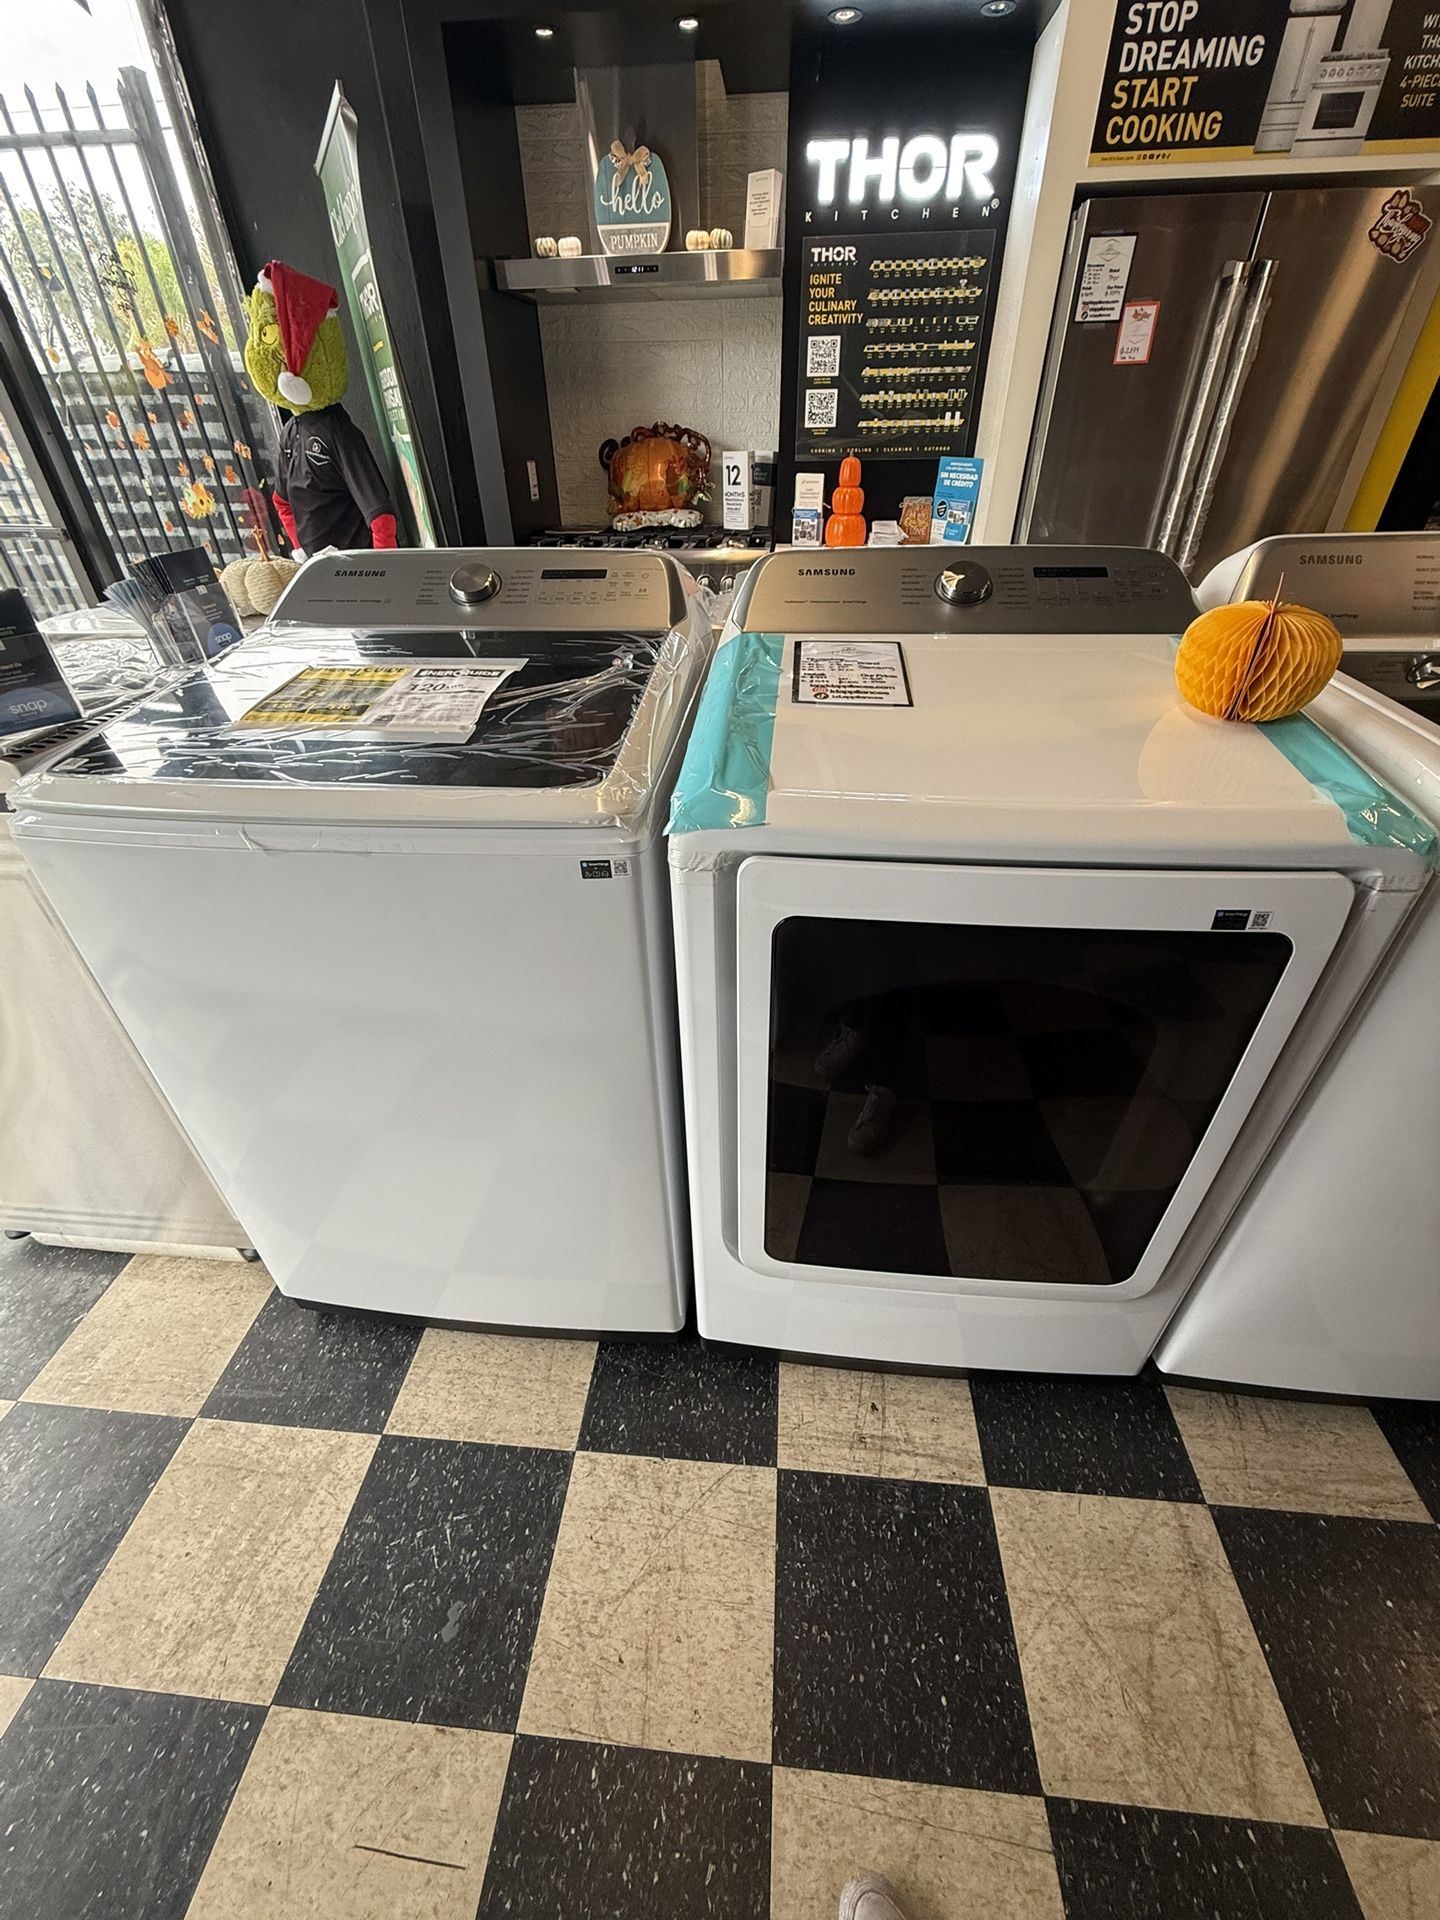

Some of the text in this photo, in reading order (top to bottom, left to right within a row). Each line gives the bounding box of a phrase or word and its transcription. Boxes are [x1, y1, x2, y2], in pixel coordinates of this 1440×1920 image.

[1125, 1, 1198, 35] STOP
[1423, 13, 1440, 29] WI
[1118, 35, 1266, 73] DREAMING
[1111, 76, 1198, 109] START
[1400, 93, 1437, 108] SUITE
[1105, 111, 1223, 145] COOKING
[805, 133, 999, 205] THOR
[600, 170, 664, 216] hello
[805, 206, 990, 223] KITCHEN
[609, 232, 659, 252] PUMPKIN
[810, 246, 857, 262] THOR
[809, 273, 842, 285] IGNITE
[809, 287, 835, 298] YOUR
[808, 300, 857, 312] CULINARY
[808, 313, 863, 325] CREATIVITY
[725, 464, 741, 486] 12
[1299, 554, 1363, 565] SAMSUNG
[334, 569, 387, 578] SAMSUNG
[798, 568, 856, 576] SAMSUNG
[410, 683, 446, 692] 120
[9, 699, 48, 715] snap
